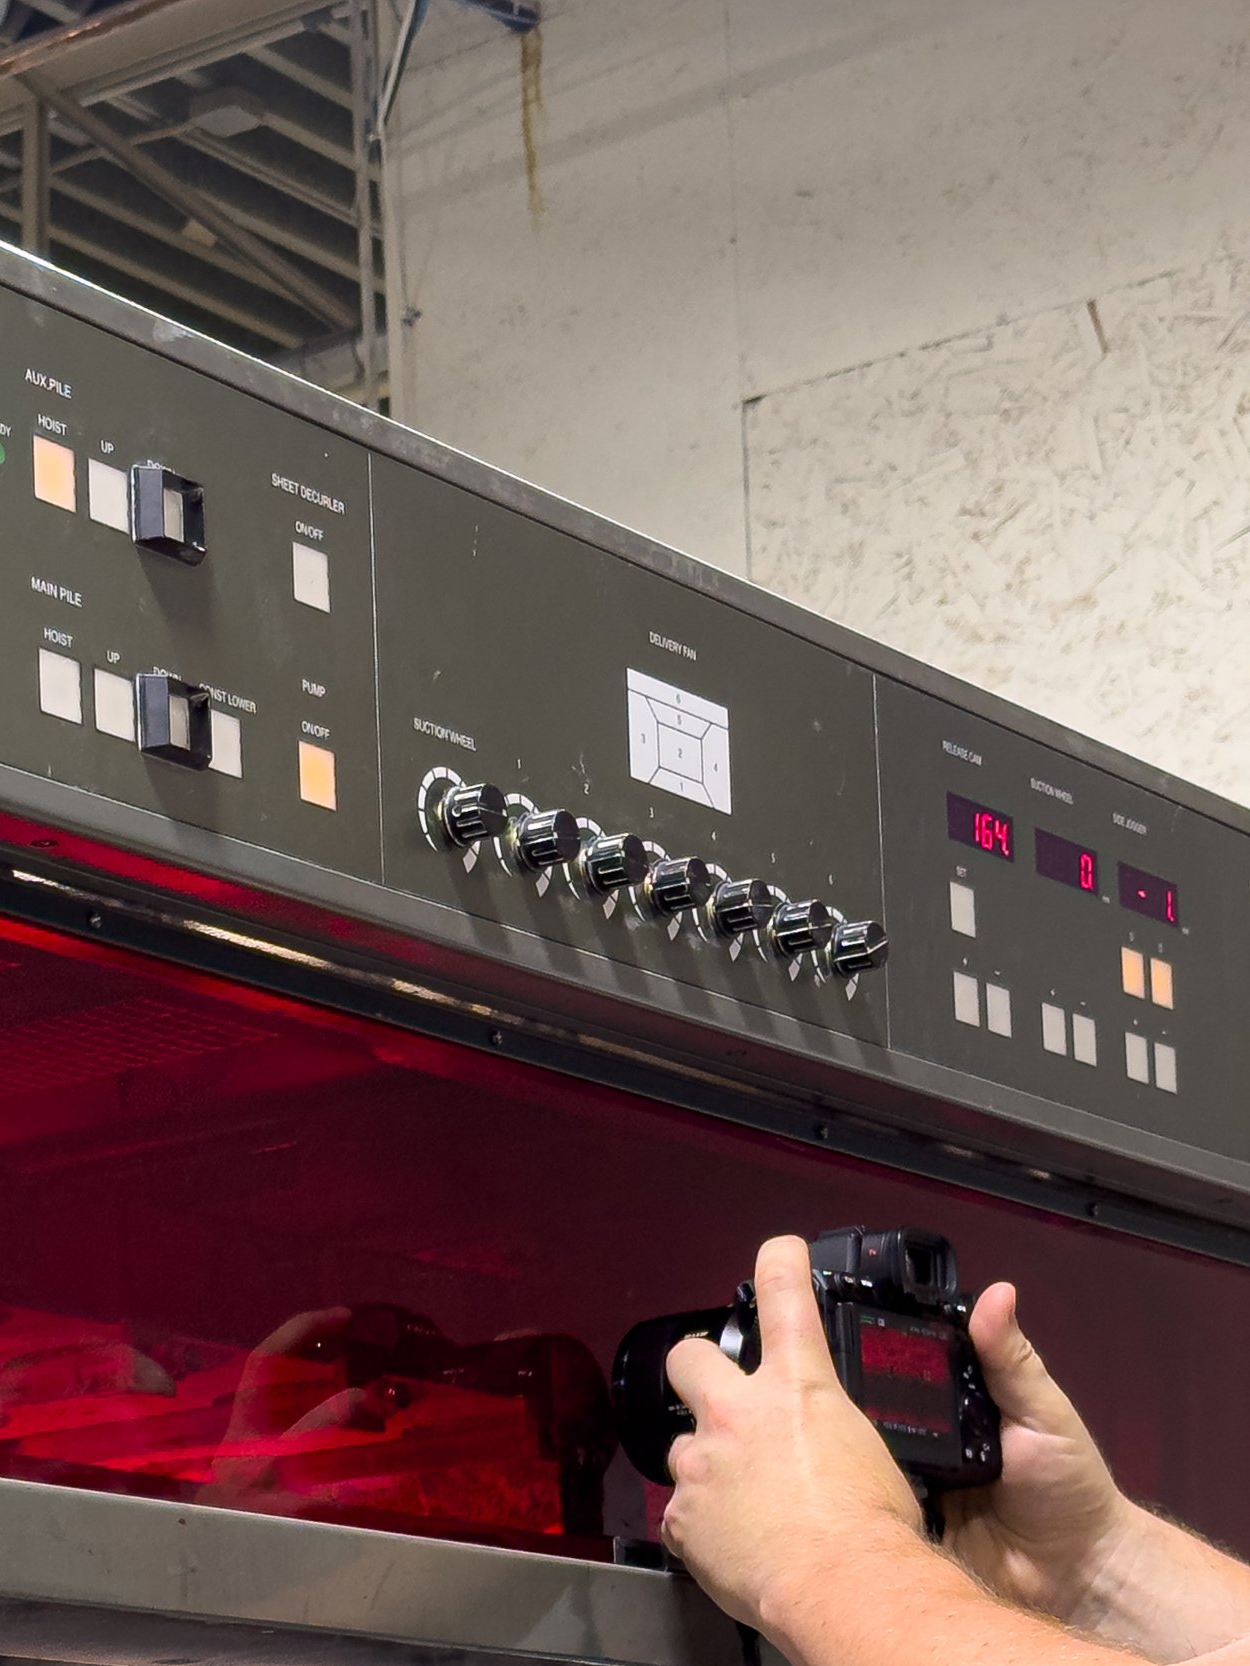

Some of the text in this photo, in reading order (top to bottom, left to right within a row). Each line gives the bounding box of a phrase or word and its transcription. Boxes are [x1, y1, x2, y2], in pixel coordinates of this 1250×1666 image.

[38, 413, 68, 436] HOIST
[101, 440, 114, 454] UP
[271, 473, 346, 514] SHEET DECURLER
[295, 520, 324, 542] ON/OFF
[31, 577, 82, 608] MAIN PILE
[43, 627, 73, 648] HOIST
[649, 631, 697, 661] DELIVERY FAN
[107, 650, 120, 665] UP
[302, 679, 326, 698] PUMP
[228, 693, 257, 715] LOWER
[301, 720, 330, 741] ON/OFF
[413, 716, 477, 752] SUCTION WHEEL
